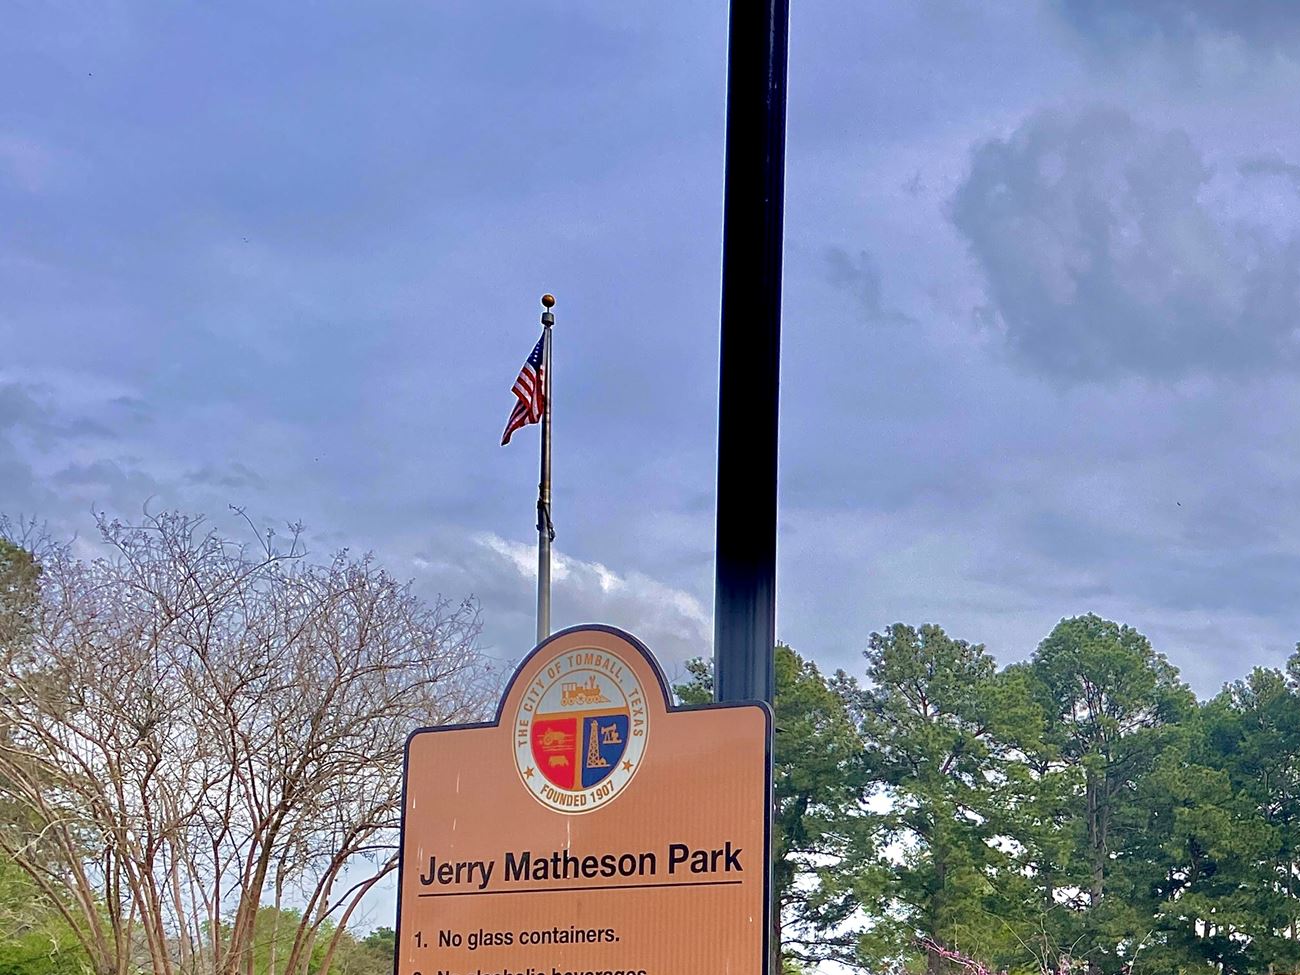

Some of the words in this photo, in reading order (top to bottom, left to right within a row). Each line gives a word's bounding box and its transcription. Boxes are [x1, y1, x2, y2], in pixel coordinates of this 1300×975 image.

[518, 719, 529, 747] THE
[525, 679, 545, 711] CITY
[548, 662, 562, 679] OF
[568, 653, 624, 683] TOMBALL,
[628, 688, 643, 737] TEXAS
[540, 784, 587, 807] FOUNDED
[590, 780, 615, 802] 1907
[419, 855, 495, 890] Jerry
[504, 849, 656, 883] Matheson
[668, 842, 743, 876] Park
[414, 931, 428, 948] 1.
[438, 929, 462, 947] No
[468, 929, 514, 951] glass
[519, 926, 620, 945] containers.
